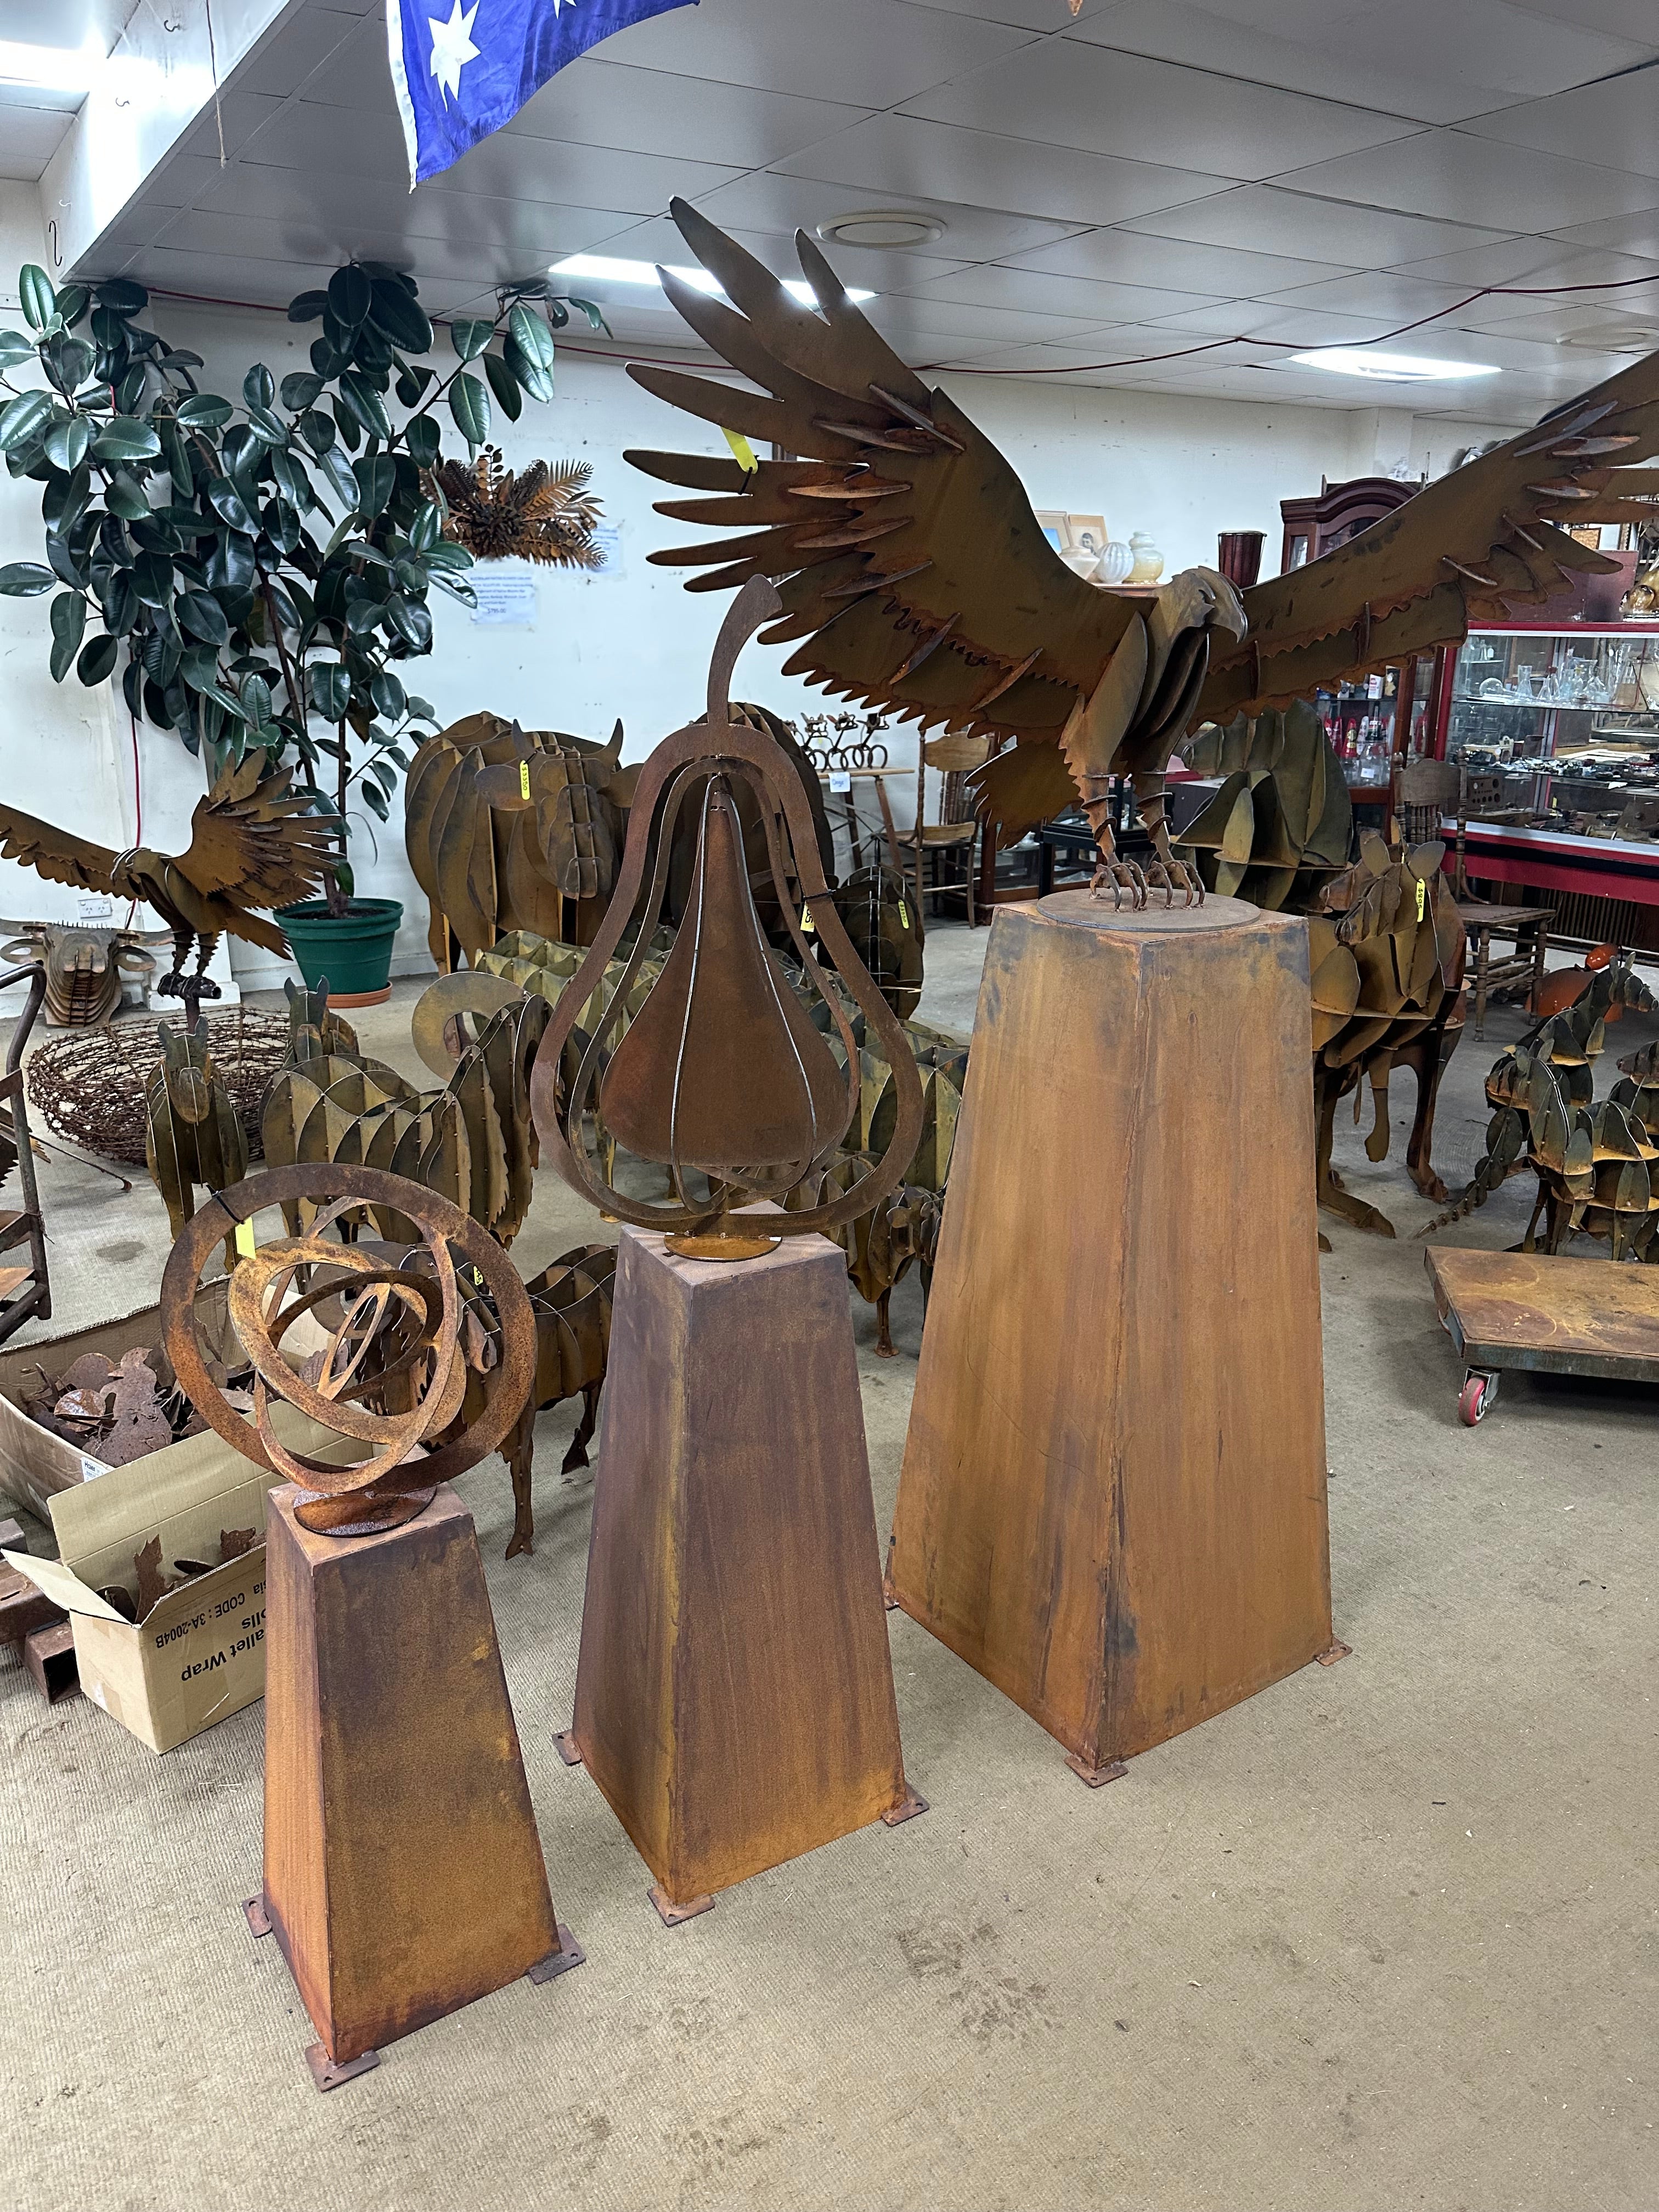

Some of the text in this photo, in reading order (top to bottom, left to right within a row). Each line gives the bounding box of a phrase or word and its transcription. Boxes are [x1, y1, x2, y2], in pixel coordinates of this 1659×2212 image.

[214, 1592, 245, 1618] CODE
[155, 1612, 206, 1649] 3A-2004B
[181, 1651, 227, 1681] Wrap
